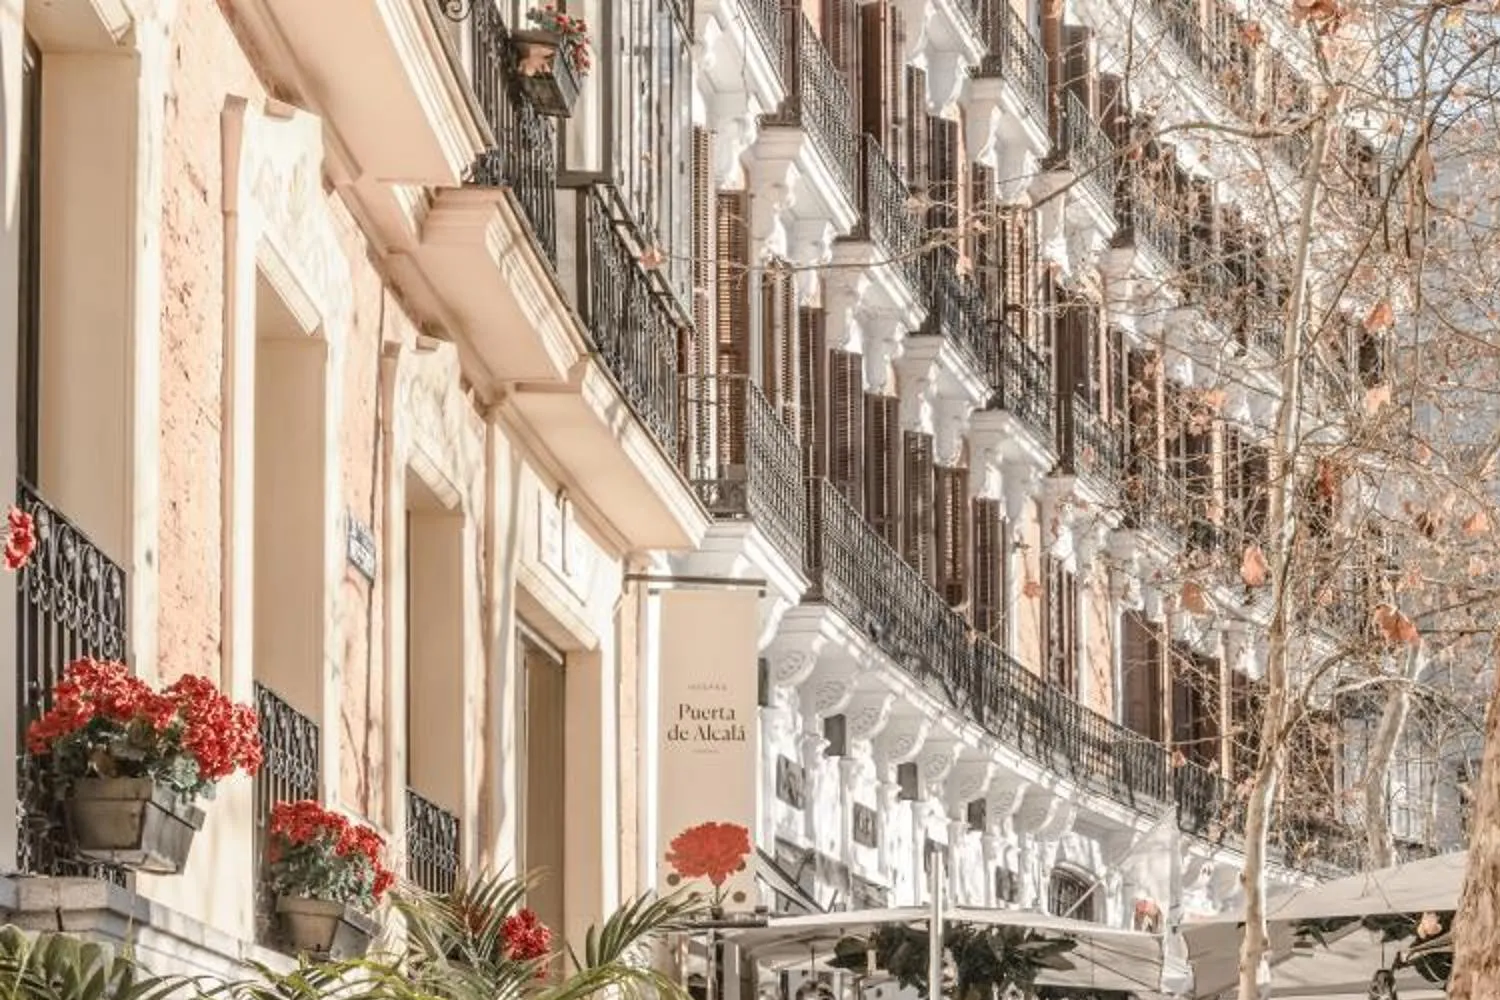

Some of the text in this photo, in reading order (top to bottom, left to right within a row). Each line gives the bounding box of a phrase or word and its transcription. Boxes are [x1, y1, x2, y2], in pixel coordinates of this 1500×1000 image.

[679, 703, 736, 720] Puerta
[667, 723, 746, 741] de Alcalá
